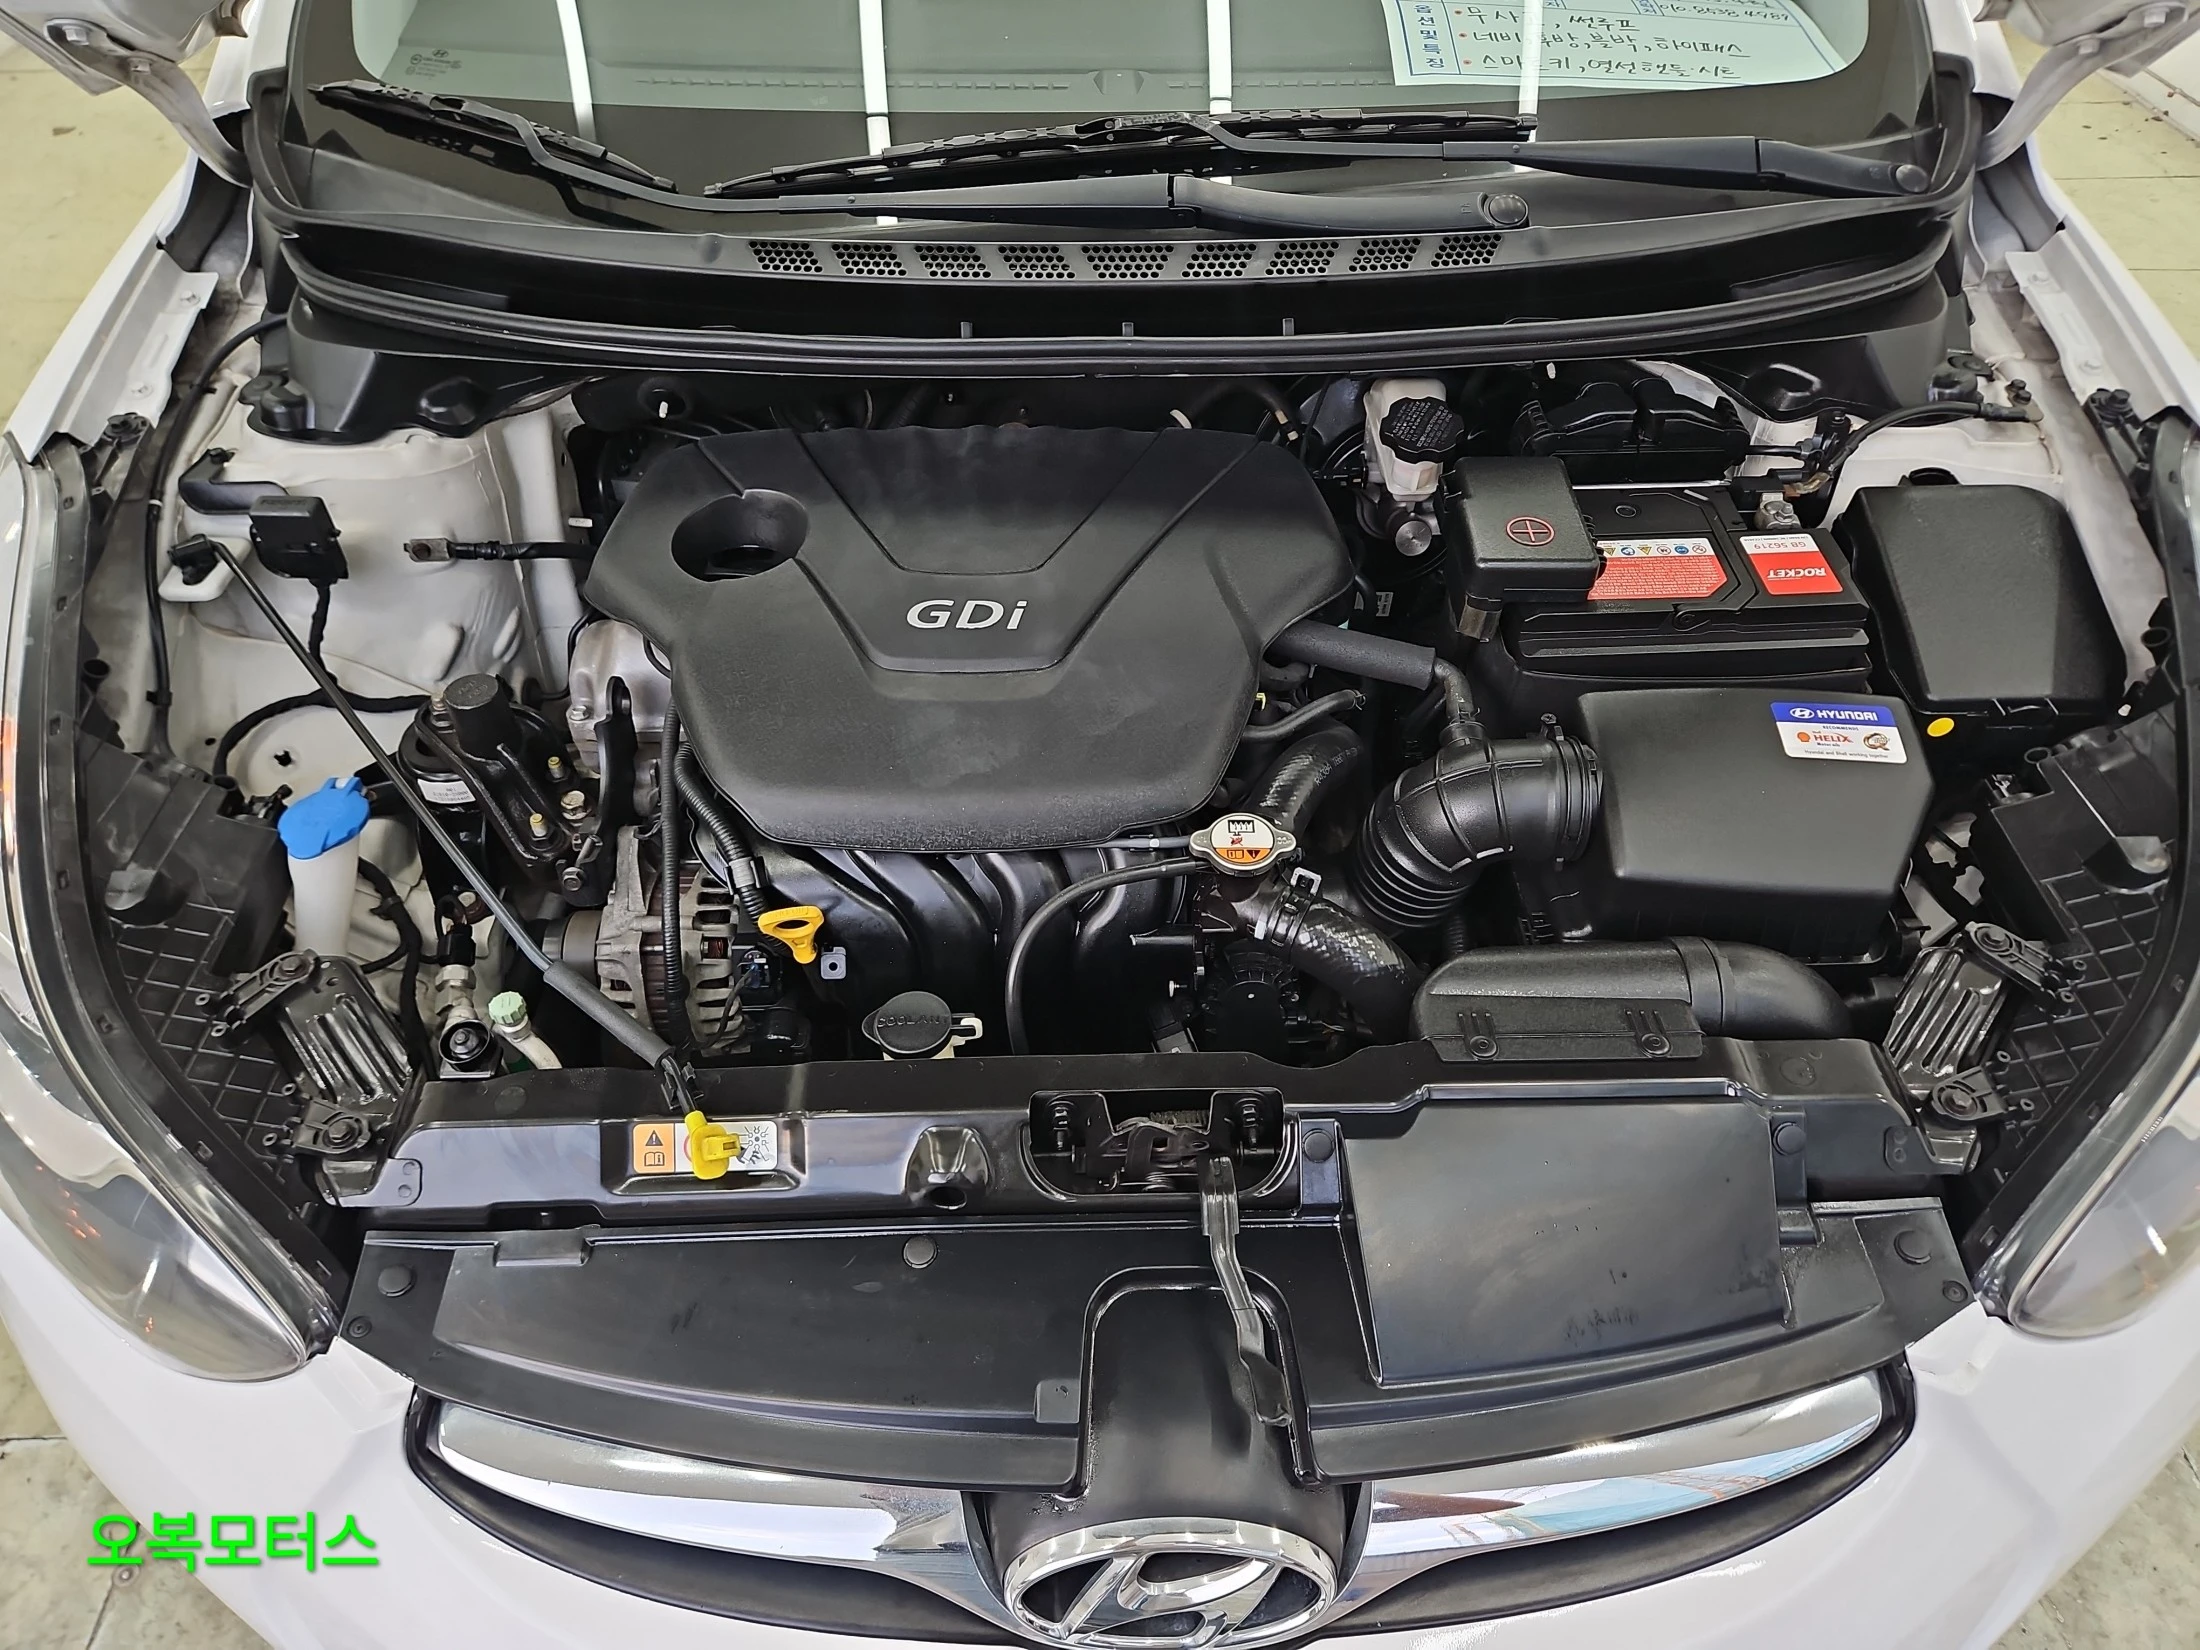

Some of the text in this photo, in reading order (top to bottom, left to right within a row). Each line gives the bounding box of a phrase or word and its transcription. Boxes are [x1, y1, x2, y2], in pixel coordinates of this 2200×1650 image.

[1766, 567, 1827, 578] ROCKET
[906, 599, 1028, 630] GDi
[1816, 709, 1879, 721] HYUNDAI
[1813, 733, 1853, 743] HELIX
